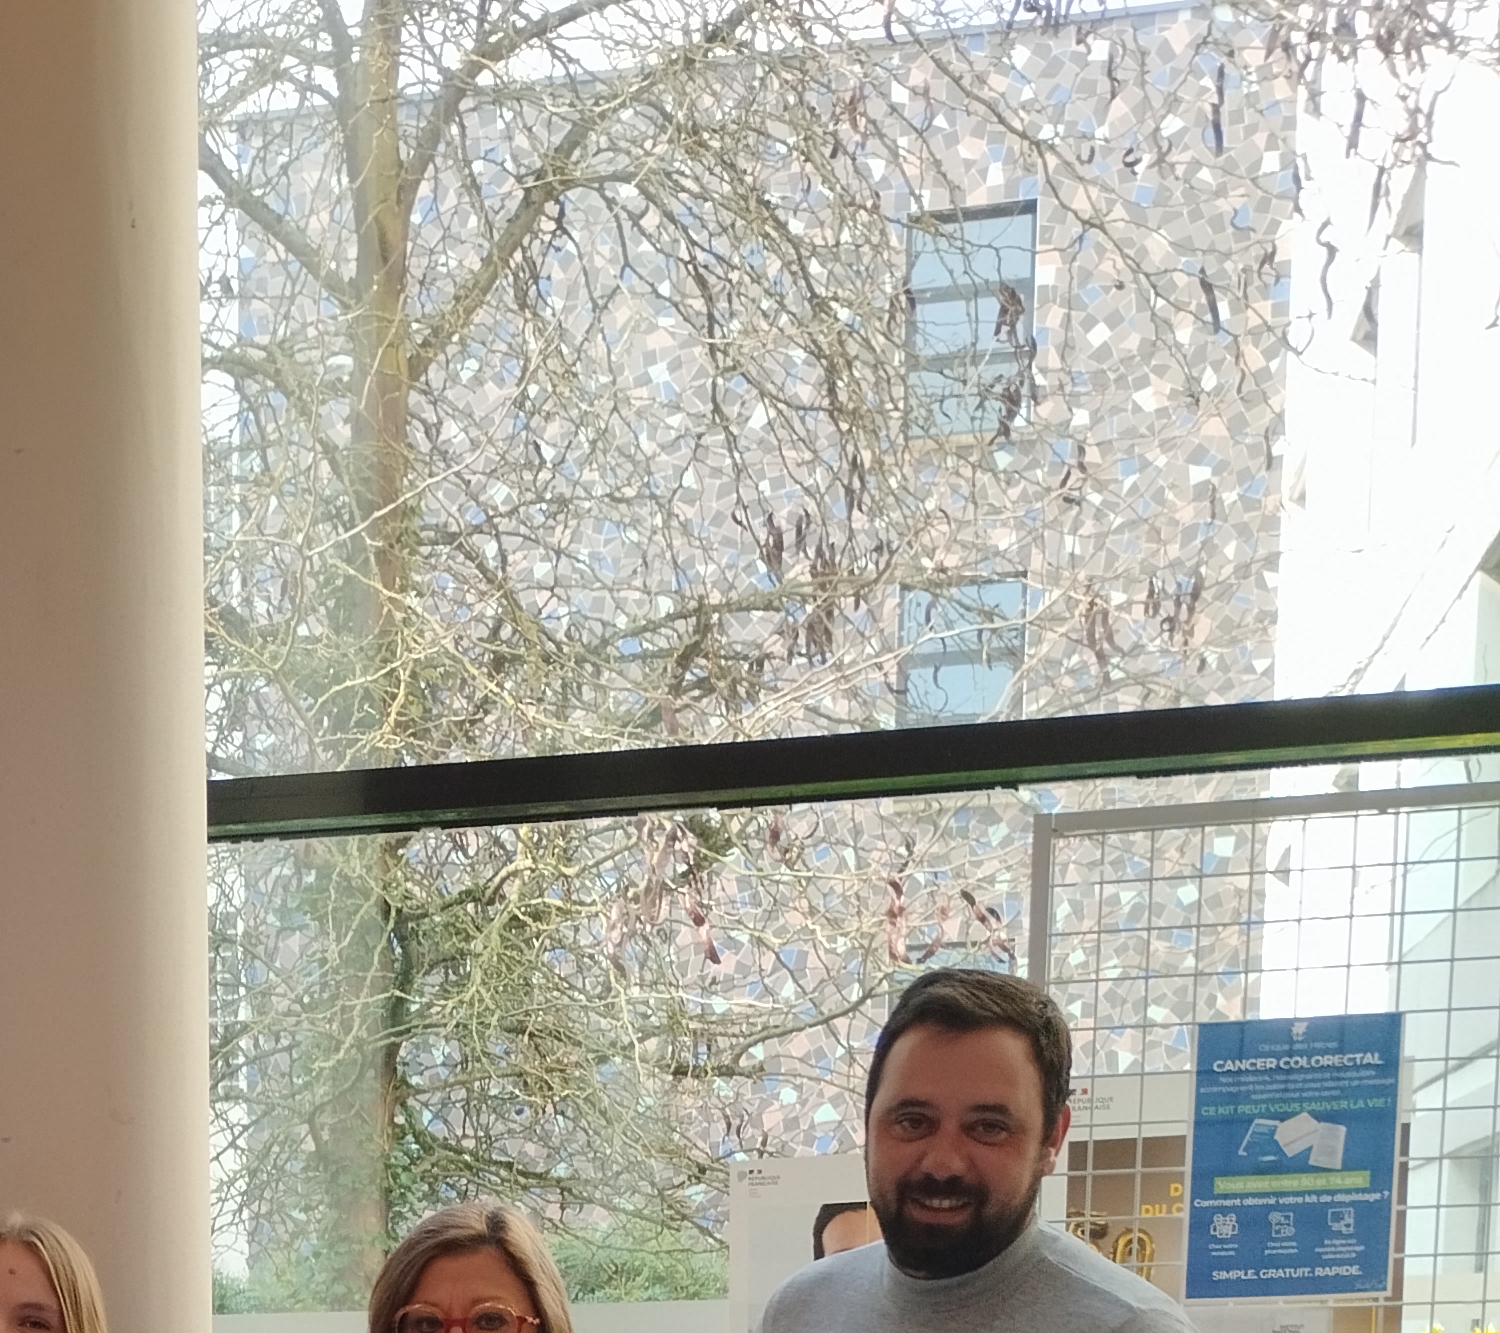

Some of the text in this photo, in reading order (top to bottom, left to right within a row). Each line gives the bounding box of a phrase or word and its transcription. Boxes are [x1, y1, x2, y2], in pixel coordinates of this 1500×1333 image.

[1213, 1052, 1383, 1073] CANCER COLORECTAL
[1218, 1105, 1235, 1115] KIT
[1237, 1104, 1267, 1115] PEUT
[1269, 1102, 1300, 1113] VOUS
[1302, 1100, 1349, 1112] SAUVER
[1350, 1099, 1366, 1109] LA
[1193, 1198, 1242, 1208] Comment
[1211, 1264, 1363, 1281] SIMPLE. GRATUIT. RAPIDE.
